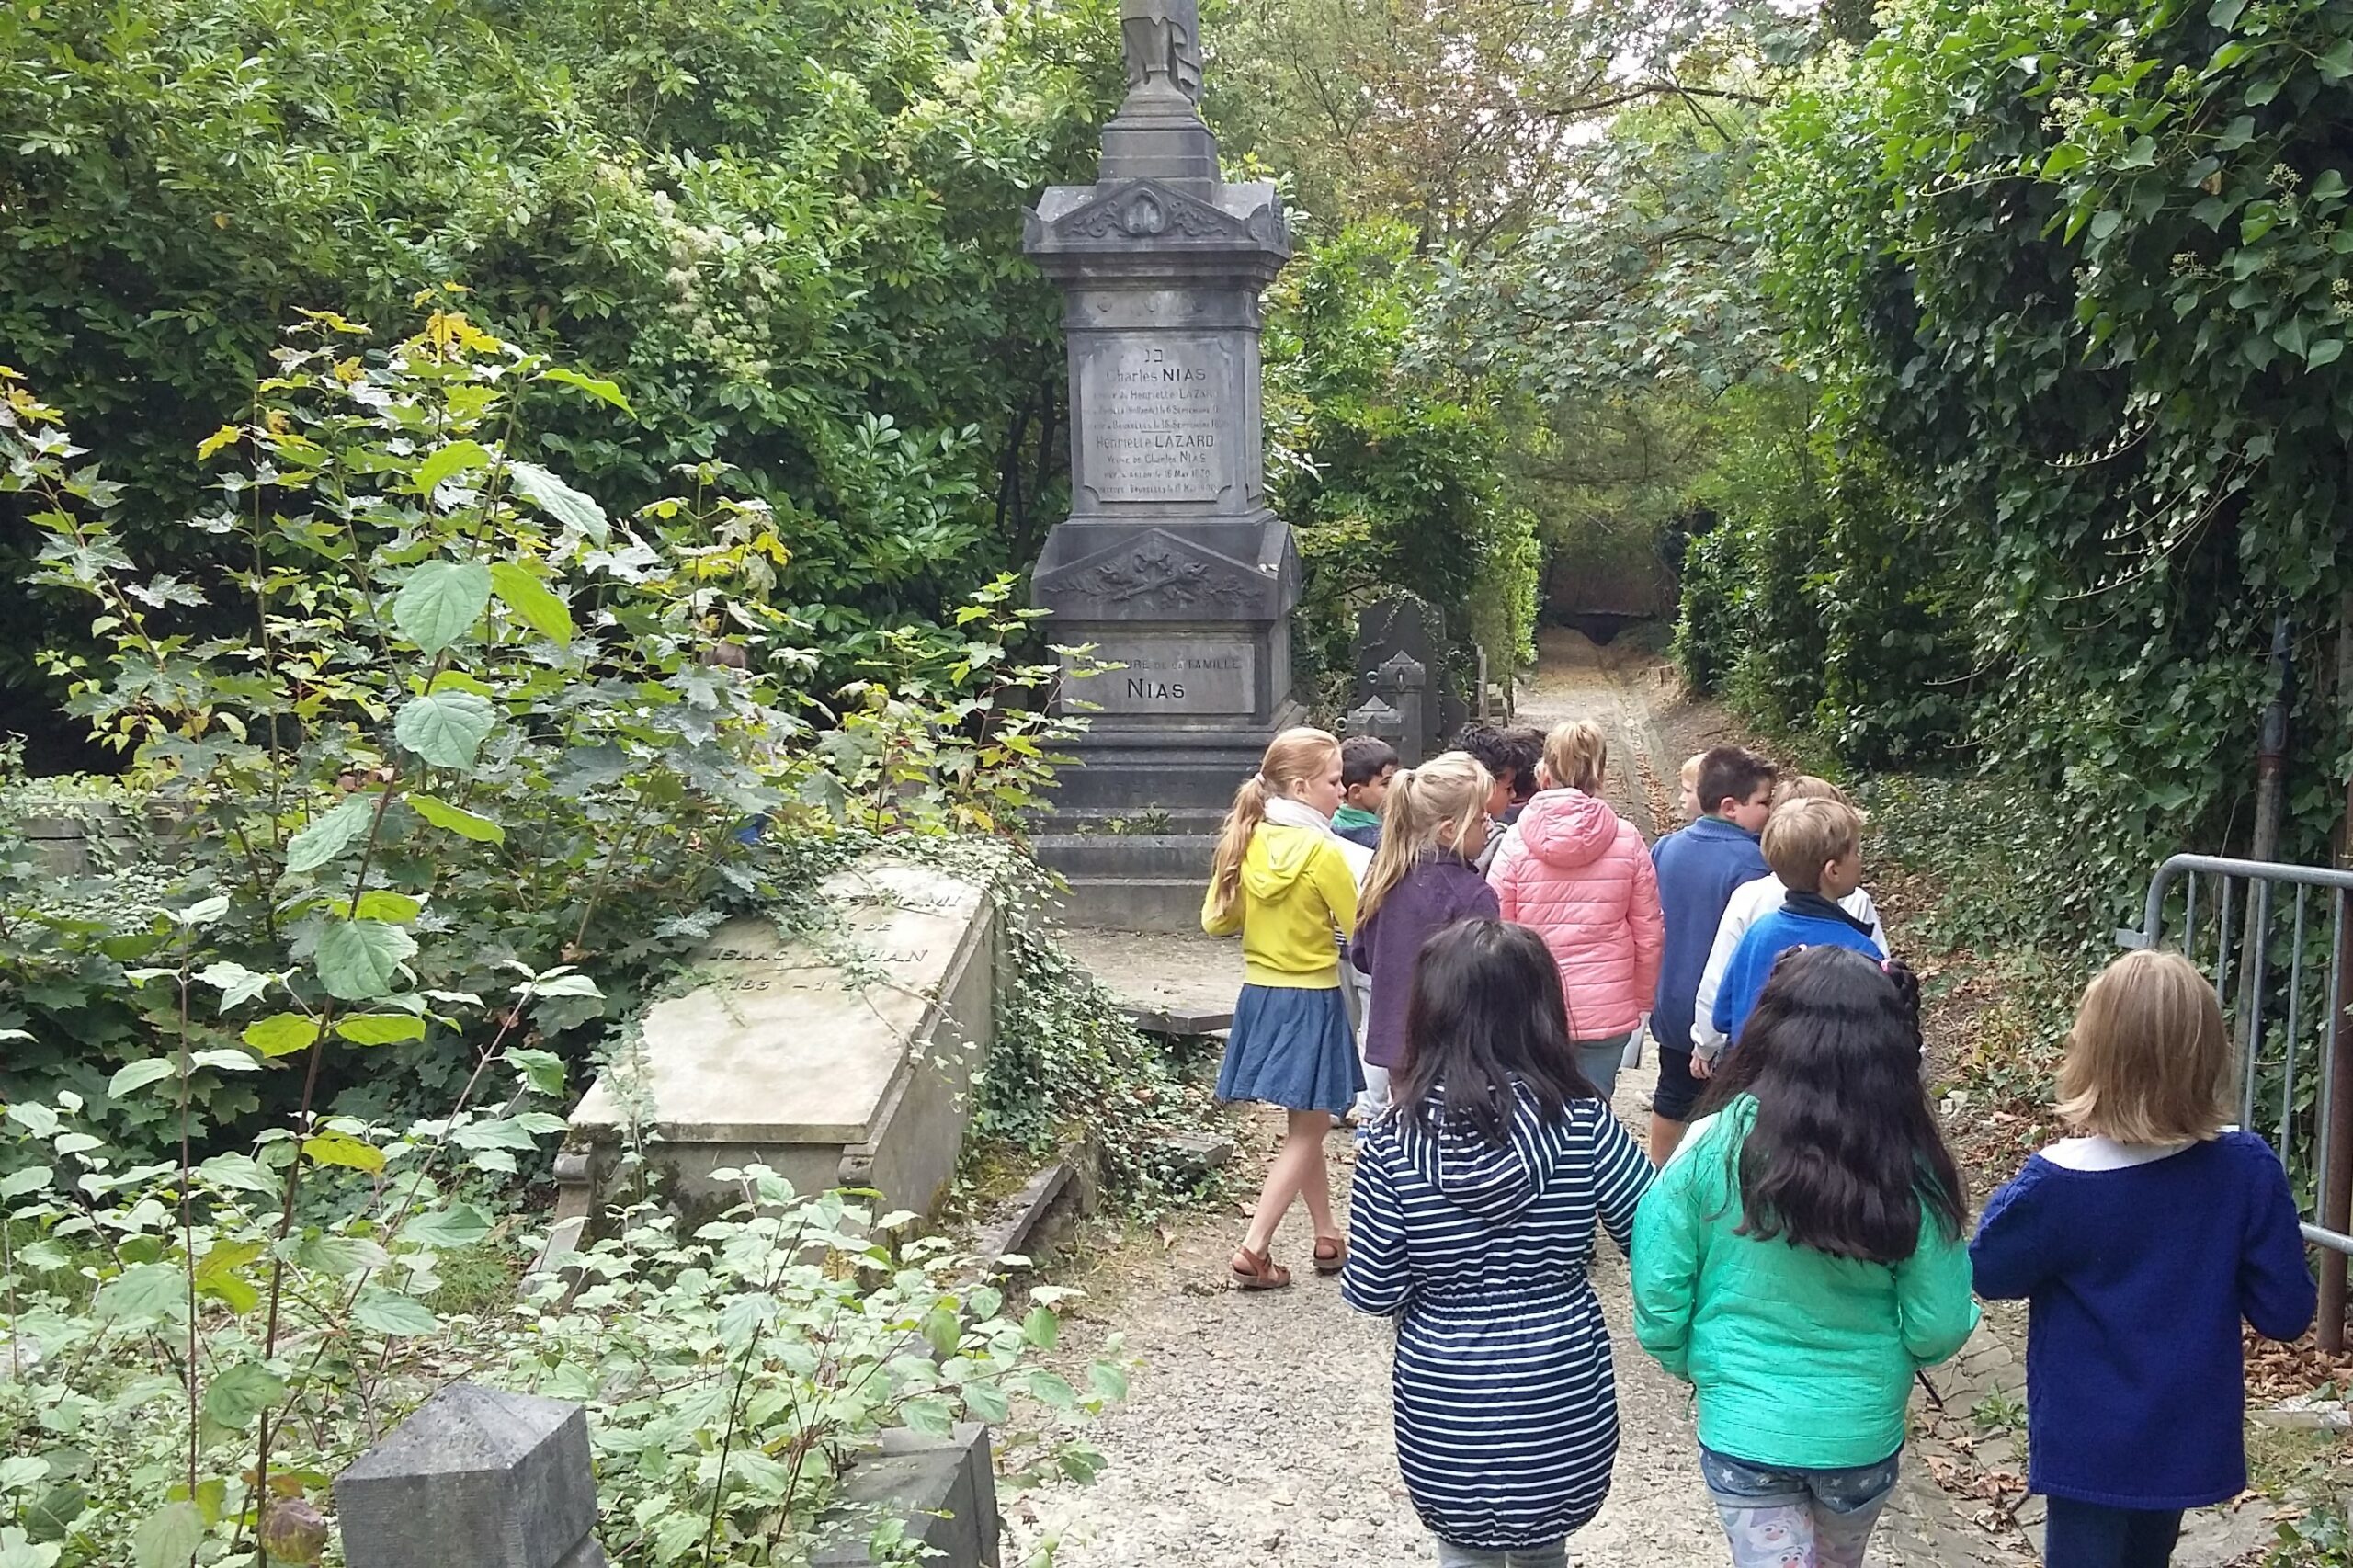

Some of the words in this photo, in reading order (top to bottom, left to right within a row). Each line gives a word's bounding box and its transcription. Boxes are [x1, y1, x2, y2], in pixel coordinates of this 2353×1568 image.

[1106, 369, 1158, 383] Charles
[1162, 368, 1208, 382] NIAS
[1096, 436, 1152, 449] Henriette
[1154, 434, 1215, 449] LAZARD
[1187, 658, 1243, 671] FAMILLE
[1126, 677, 1186, 700] NIAS
[708, 948, 789, 961] ISAAC
